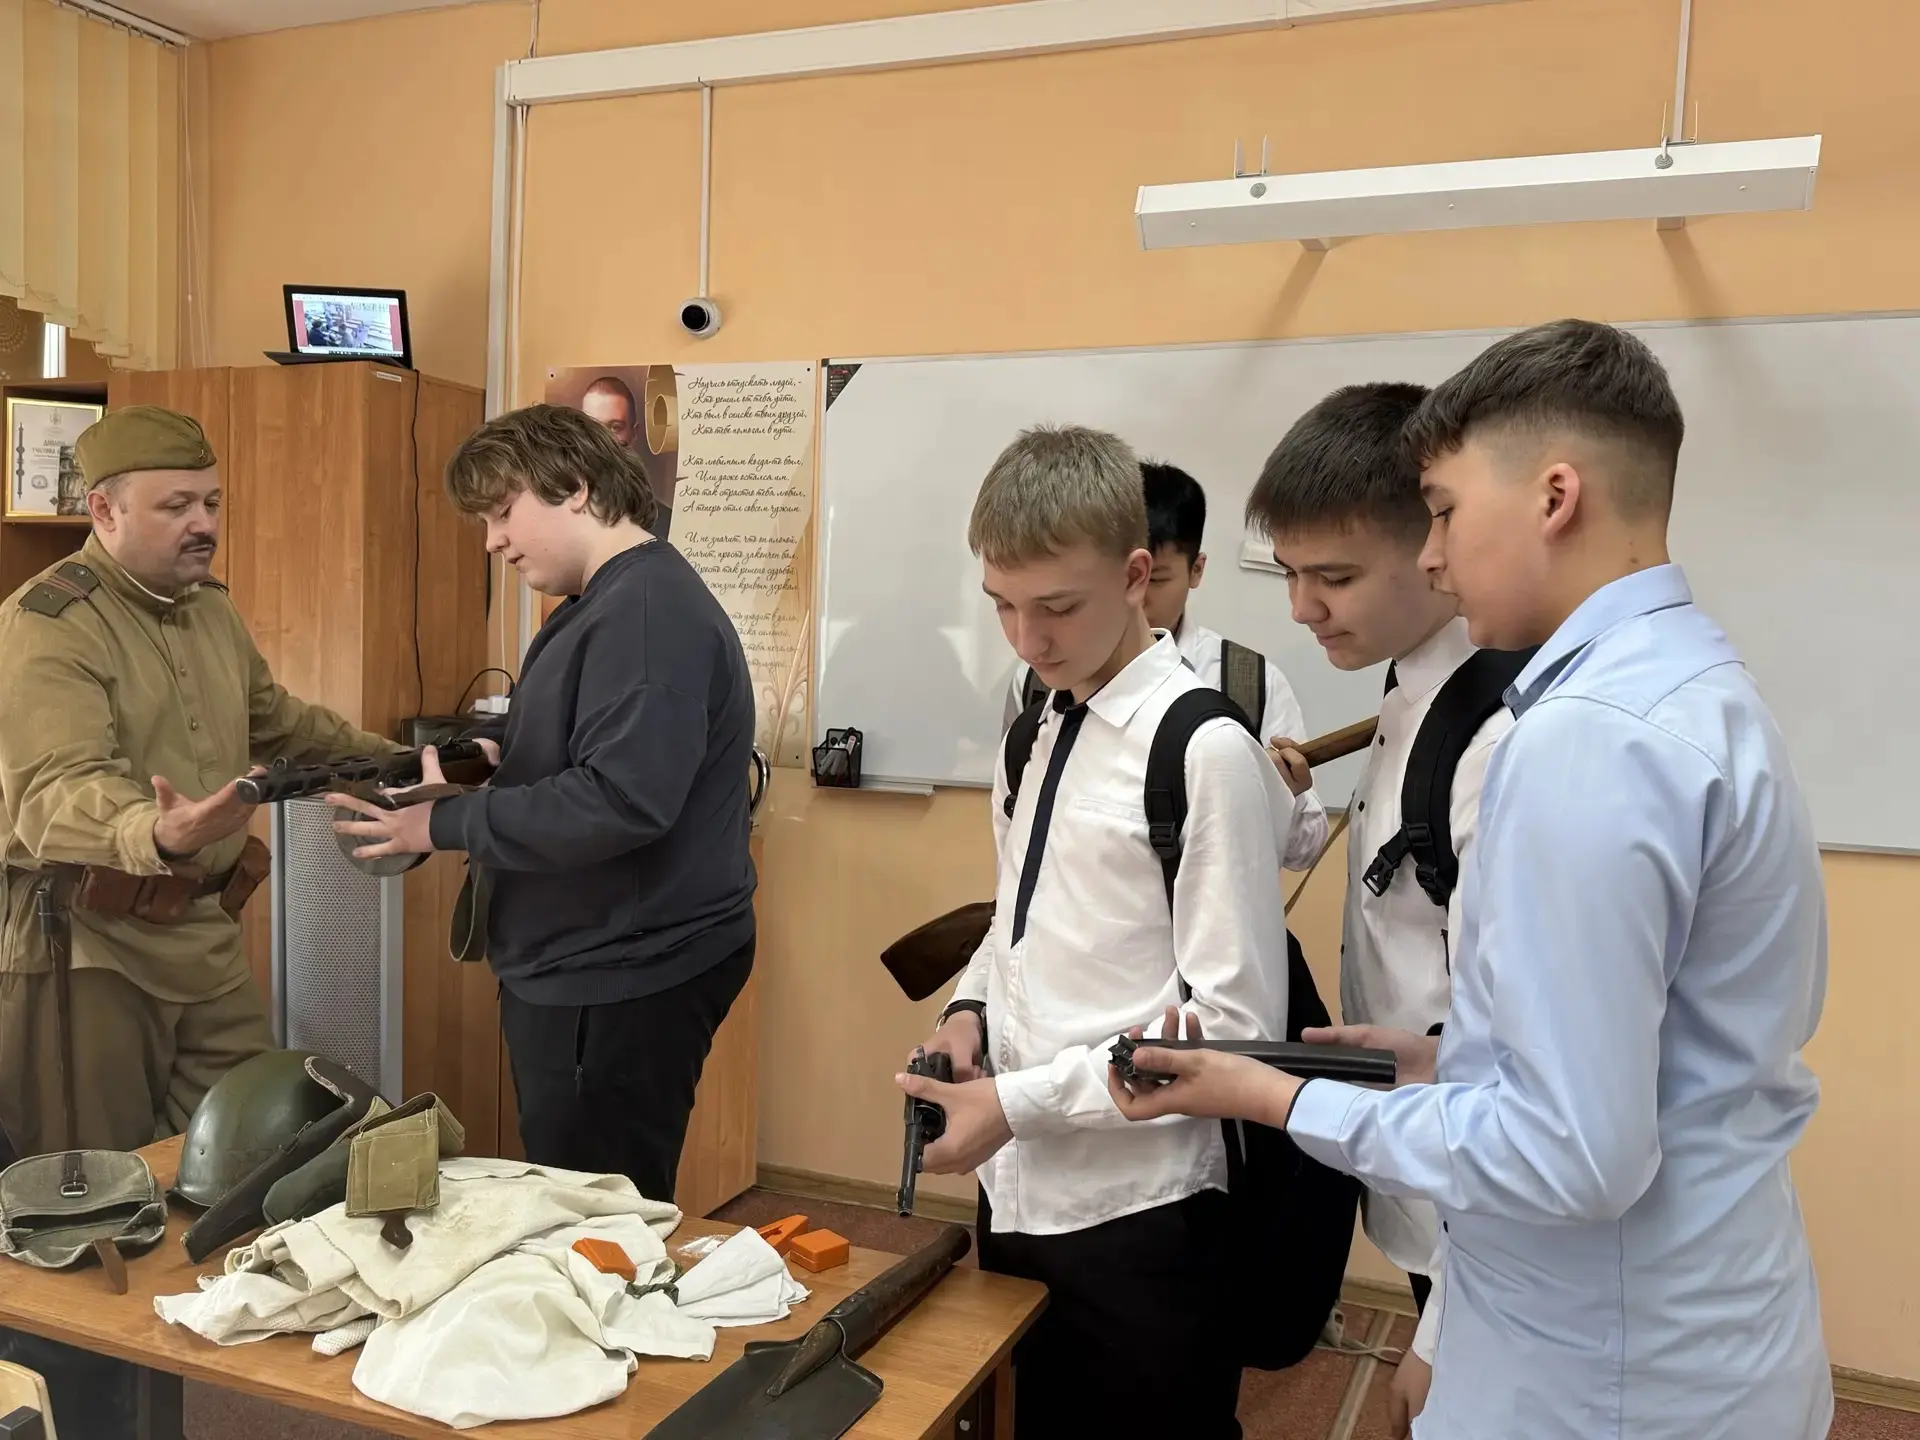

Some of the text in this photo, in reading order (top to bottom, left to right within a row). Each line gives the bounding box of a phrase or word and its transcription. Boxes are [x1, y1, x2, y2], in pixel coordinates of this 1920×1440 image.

[688, 376, 726, 396] Научись
[727, 375, 768, 393] отпускать
[692, 393, 713, 404] Кто
[713, 396, 740, 408] решил
[742, 395, 754, 403] от
[754, 392, 772, 402] тебя
[681, 408, 702, 420] Кто
[704, 409, 721, 419] был
[722, 405, 730, 419] в
[729, 406, 753, 419] списке
[754, 405, 776, 418] твоих
[692, 424, 713, 435] Кто
[714, 424, 732, 434] тебе
[732, 426, 765, 434] помогал
[683, 454, 704, 466] Кто
[705, 456, 746, 465] любимым
[696, 470, 716, 481] Или
[714, 474, 739, 486] даже
[740, 473, 772, 481] остался
[679, 485, 701, 497] Кто
[702, 485, 720, 496] так
[720, 488, 755, 501] страстно
[756, 487, 775, 497] тебя
[683, 500, 696, 513] А
[696, 503, 722, 516] теперь
[722, 504, 742, 512] стал
[744, 499, 769, 512] совсем
[744, 535, 757, 543] что
[717, 551, 744, 563] просто
[741, 547, 780, 564] закончен
[722, 562, 738, 573] так
[737, 566, 765, 578] решено
[738, 576, 767, 593] кривых
